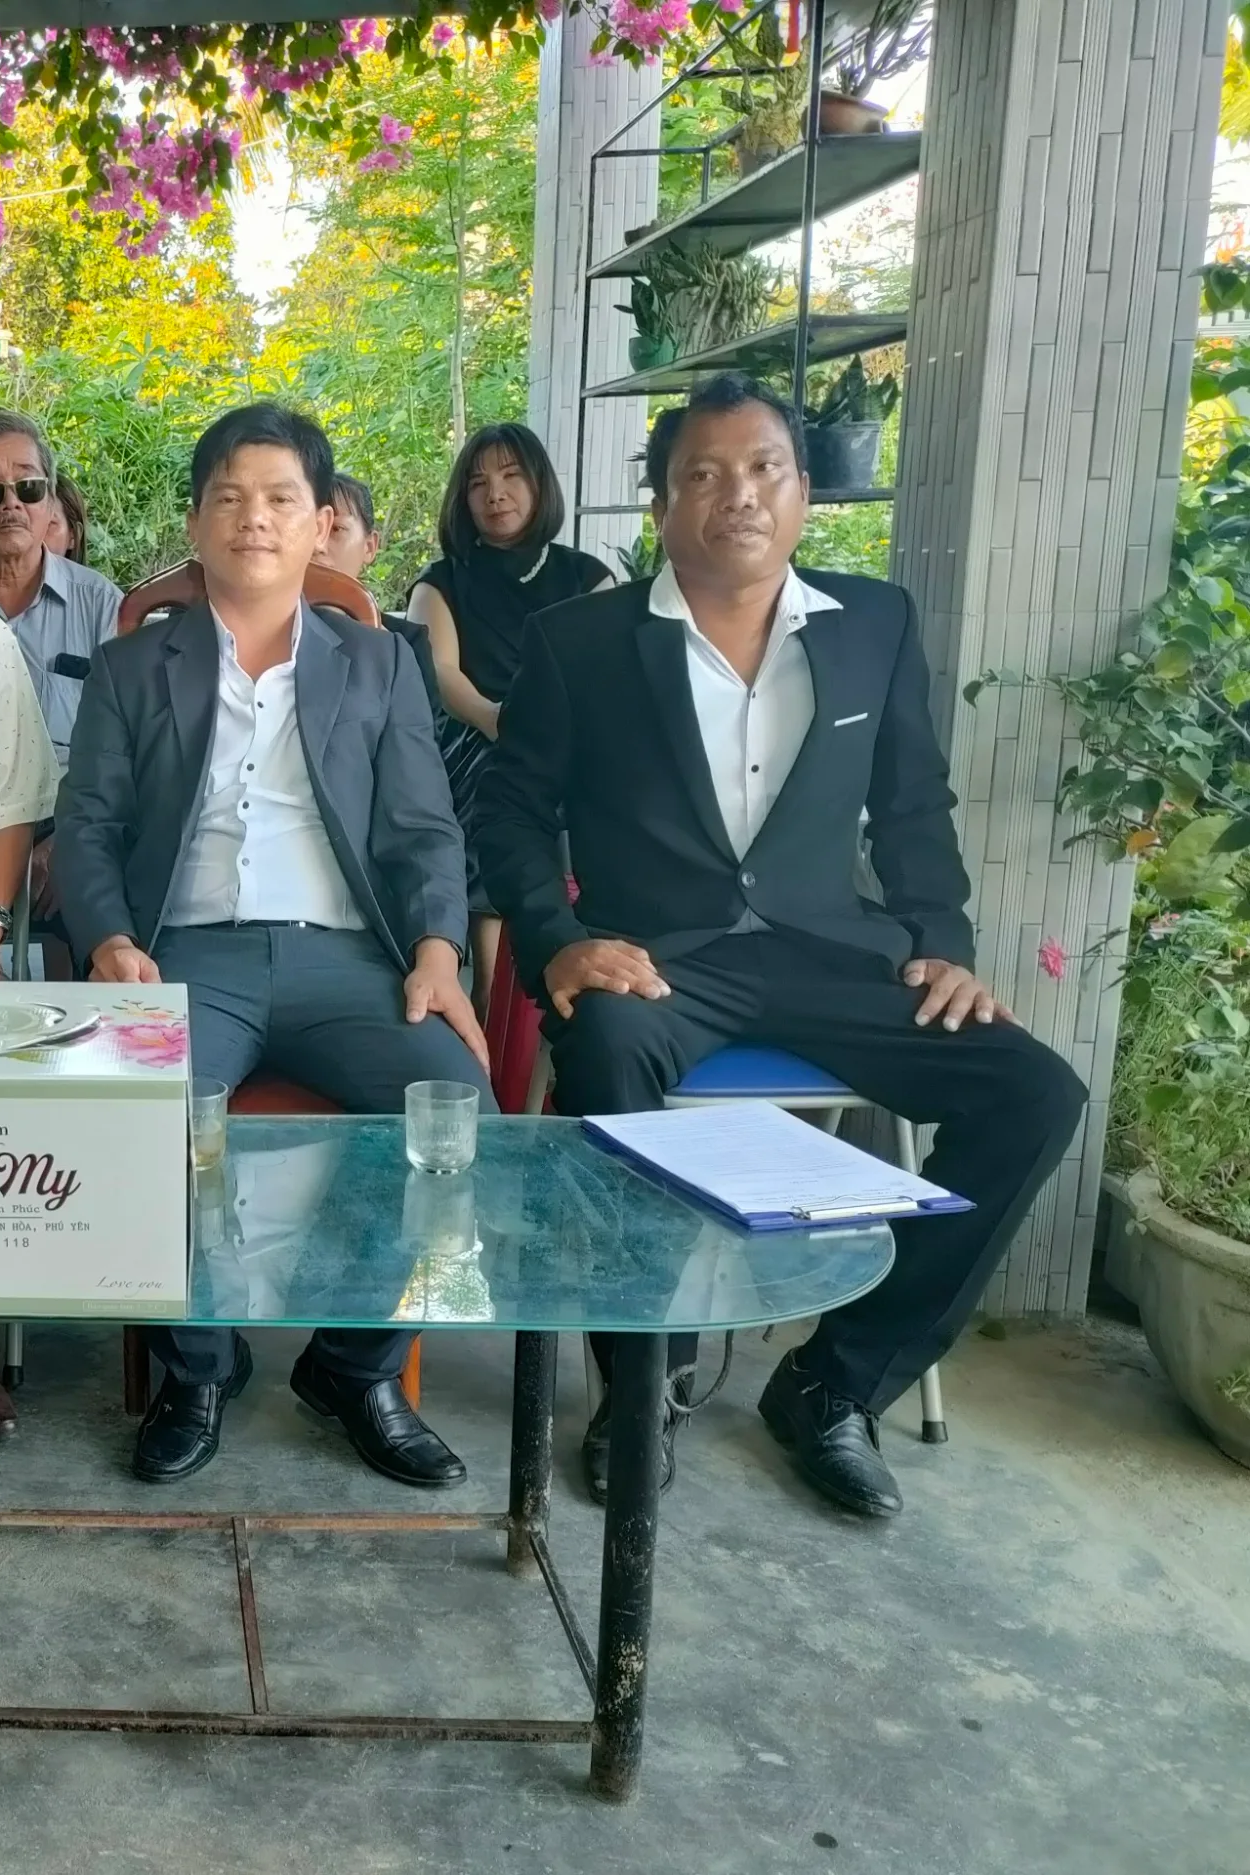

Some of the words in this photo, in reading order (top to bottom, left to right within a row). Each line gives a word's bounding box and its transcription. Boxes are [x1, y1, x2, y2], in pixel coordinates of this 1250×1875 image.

[12, 1204, 41, 1213] Phúc
[12, 1220, 37, 1233] HÒA,
[45, 1220, 64, 1232] PHÚ
[70, 1221, 90, 1232] YÊN
[4, 1237, 30, 1248] 118
[96, 1275, 133, 1289] Love
